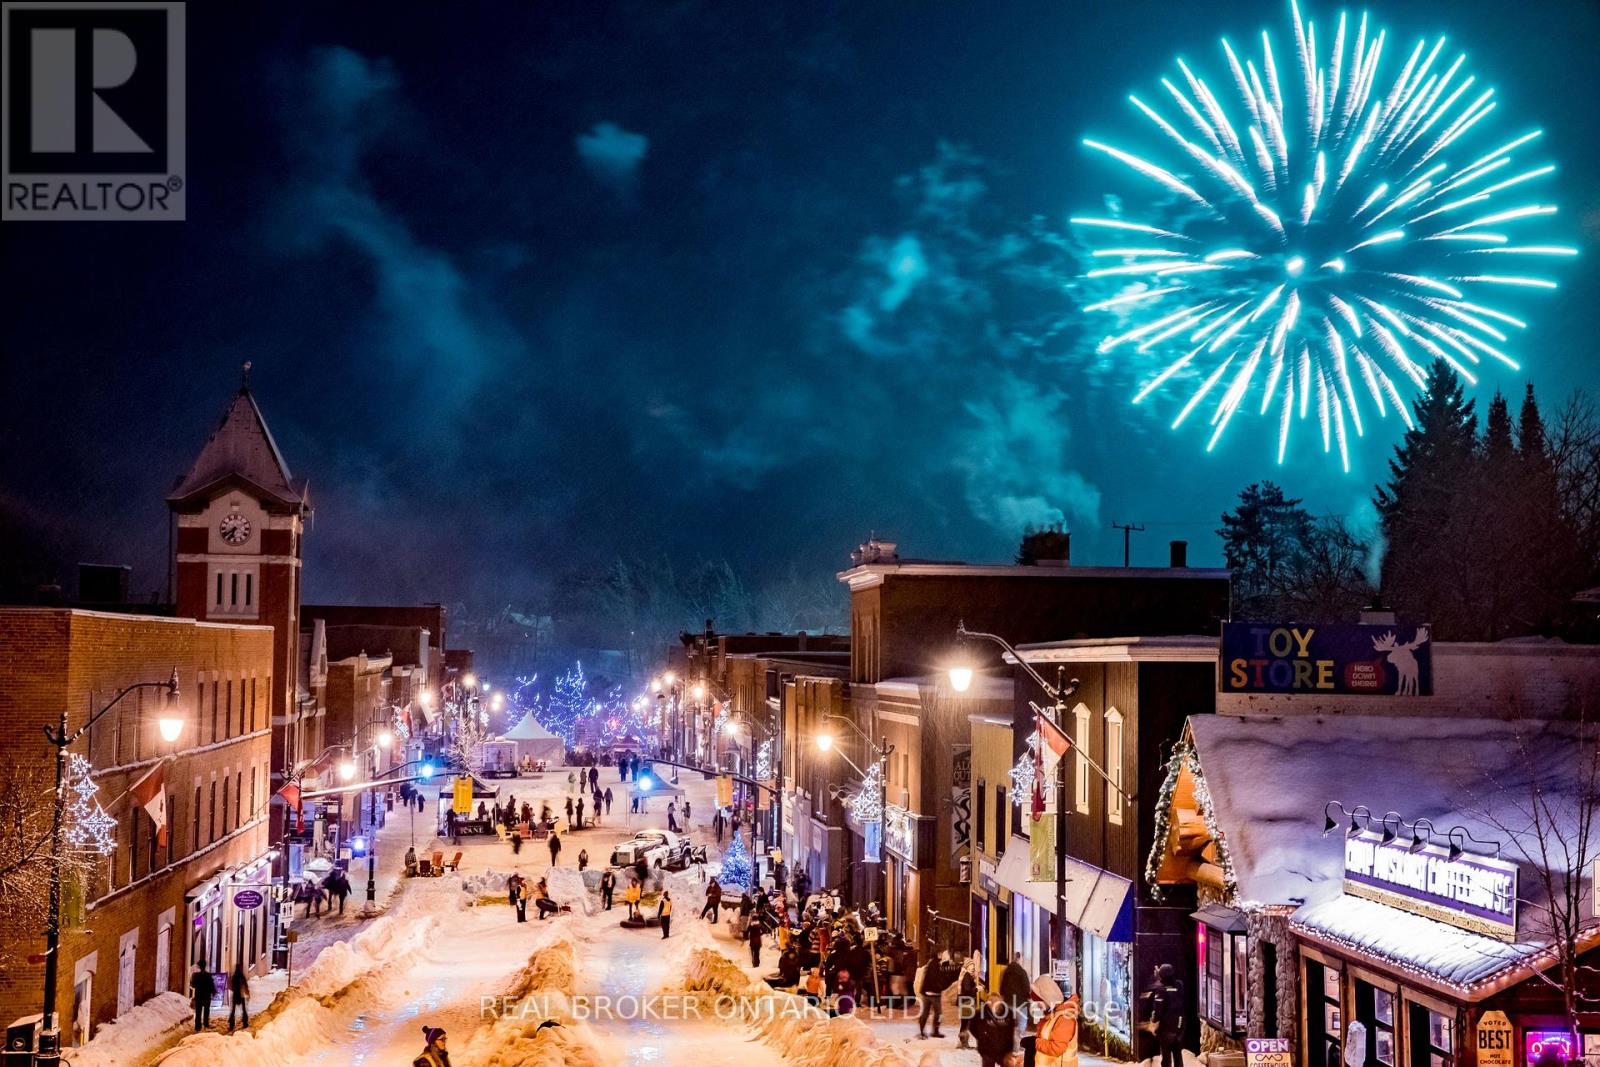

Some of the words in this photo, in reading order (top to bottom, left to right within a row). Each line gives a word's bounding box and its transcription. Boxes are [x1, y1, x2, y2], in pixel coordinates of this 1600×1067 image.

[1250, 627, 1315, 657] TOY
[1230, 658, 1335, 689] STORE
[1248, 1040, 1289, 1052] OPEN
[1479, 1030, 1511, 1049] BEST
[1531, 1041, 1570, 1058] ON
